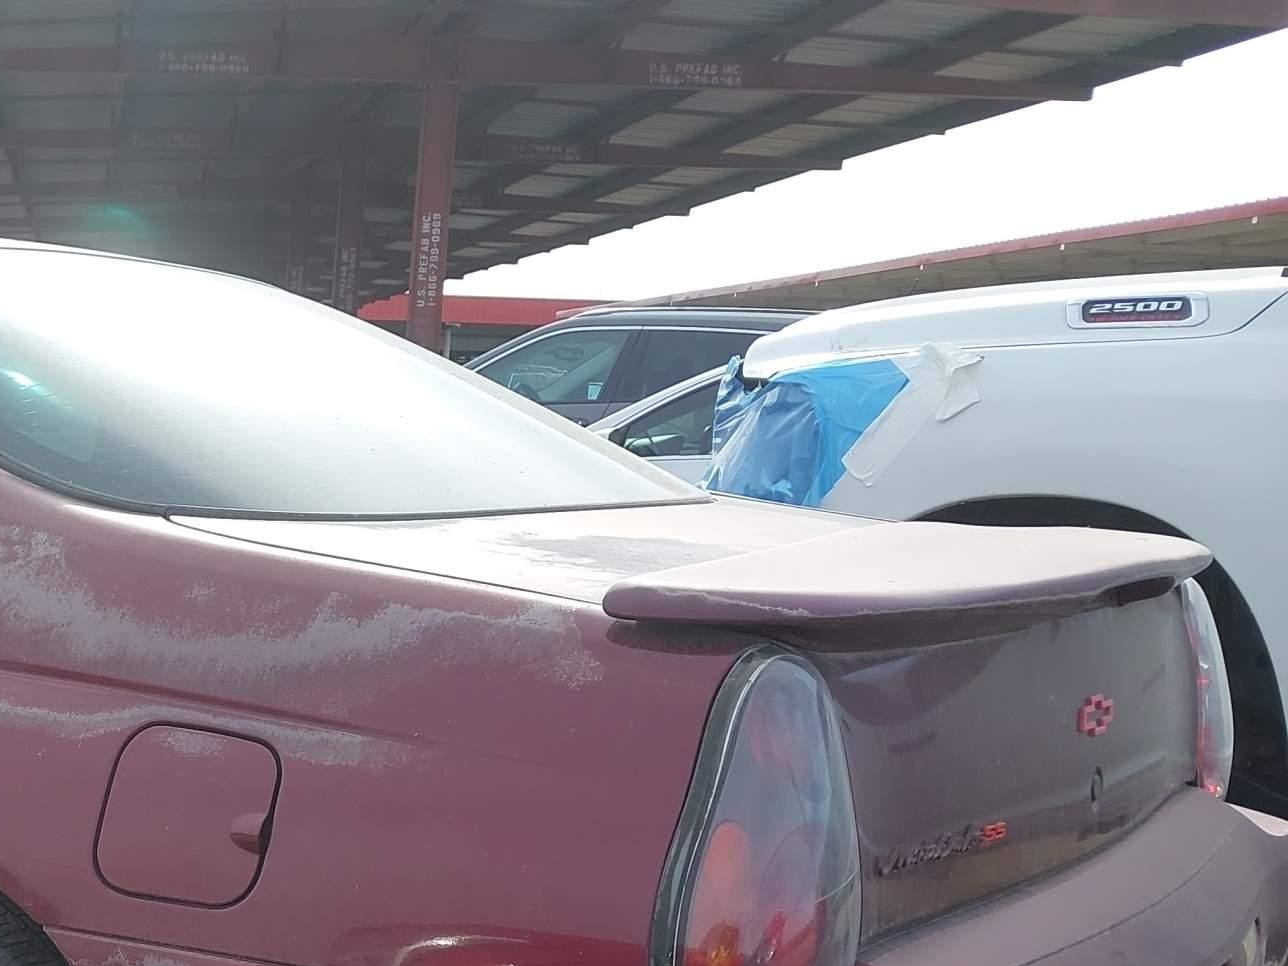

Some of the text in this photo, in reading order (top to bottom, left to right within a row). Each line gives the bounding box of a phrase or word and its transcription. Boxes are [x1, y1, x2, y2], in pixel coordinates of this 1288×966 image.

[418, 238, 430, 281] PREFAB
[416, 286, 427, 308] U.S.
[1088, 301, 1183, 314] 2500
[982, 821, 1008, 842] SS
